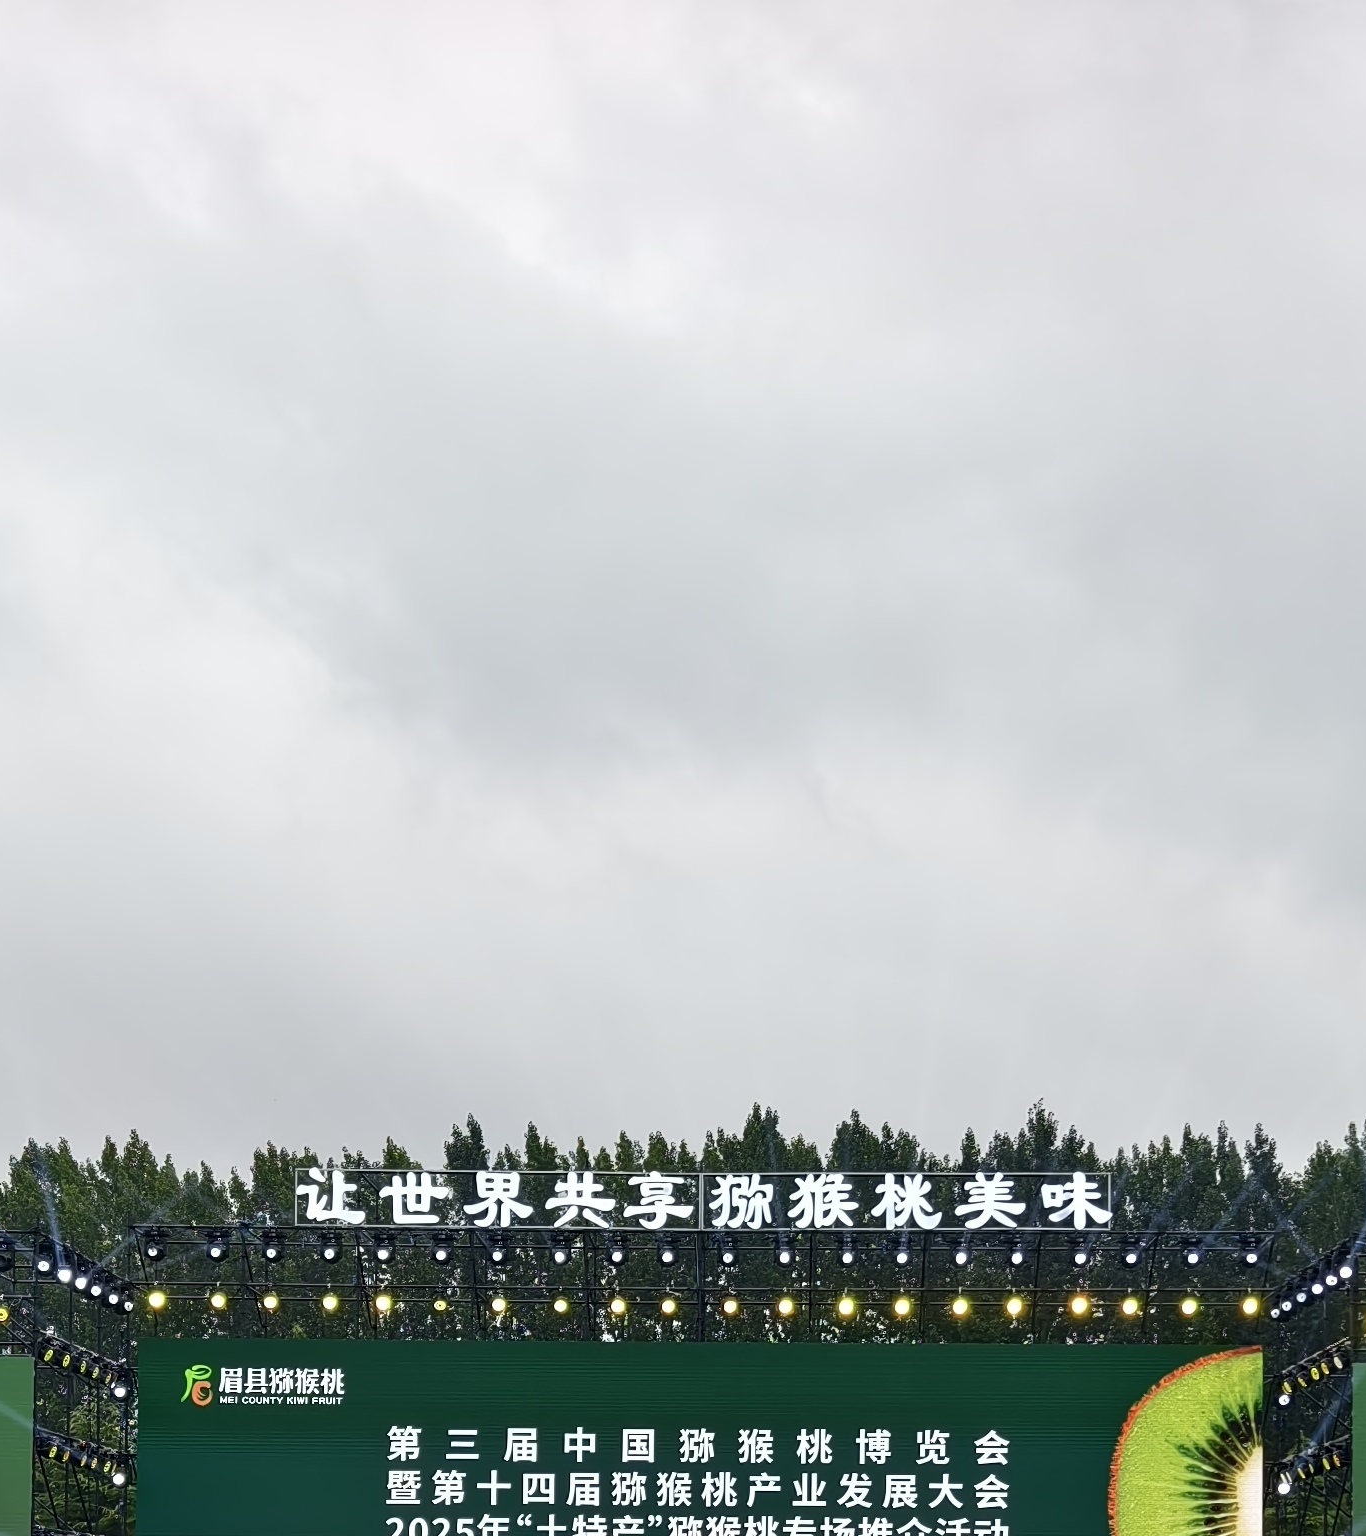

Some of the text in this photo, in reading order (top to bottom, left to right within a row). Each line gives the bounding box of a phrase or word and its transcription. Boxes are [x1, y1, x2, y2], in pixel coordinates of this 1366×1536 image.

[296, 1167, 1114, 1231] 让世界共享猕猴桃美味
[218, 1367, 345, 1395] 眉县猕猴桃
[219, 1396, 344, 1406] MEI COUNTY KIWI FRUIT
[386, 1425, 1010, 1466] 第三届中国猕猴桃博览会
[385, 1469, 1010, 1510] 暨第十四届猕猴桃产业发展大会
